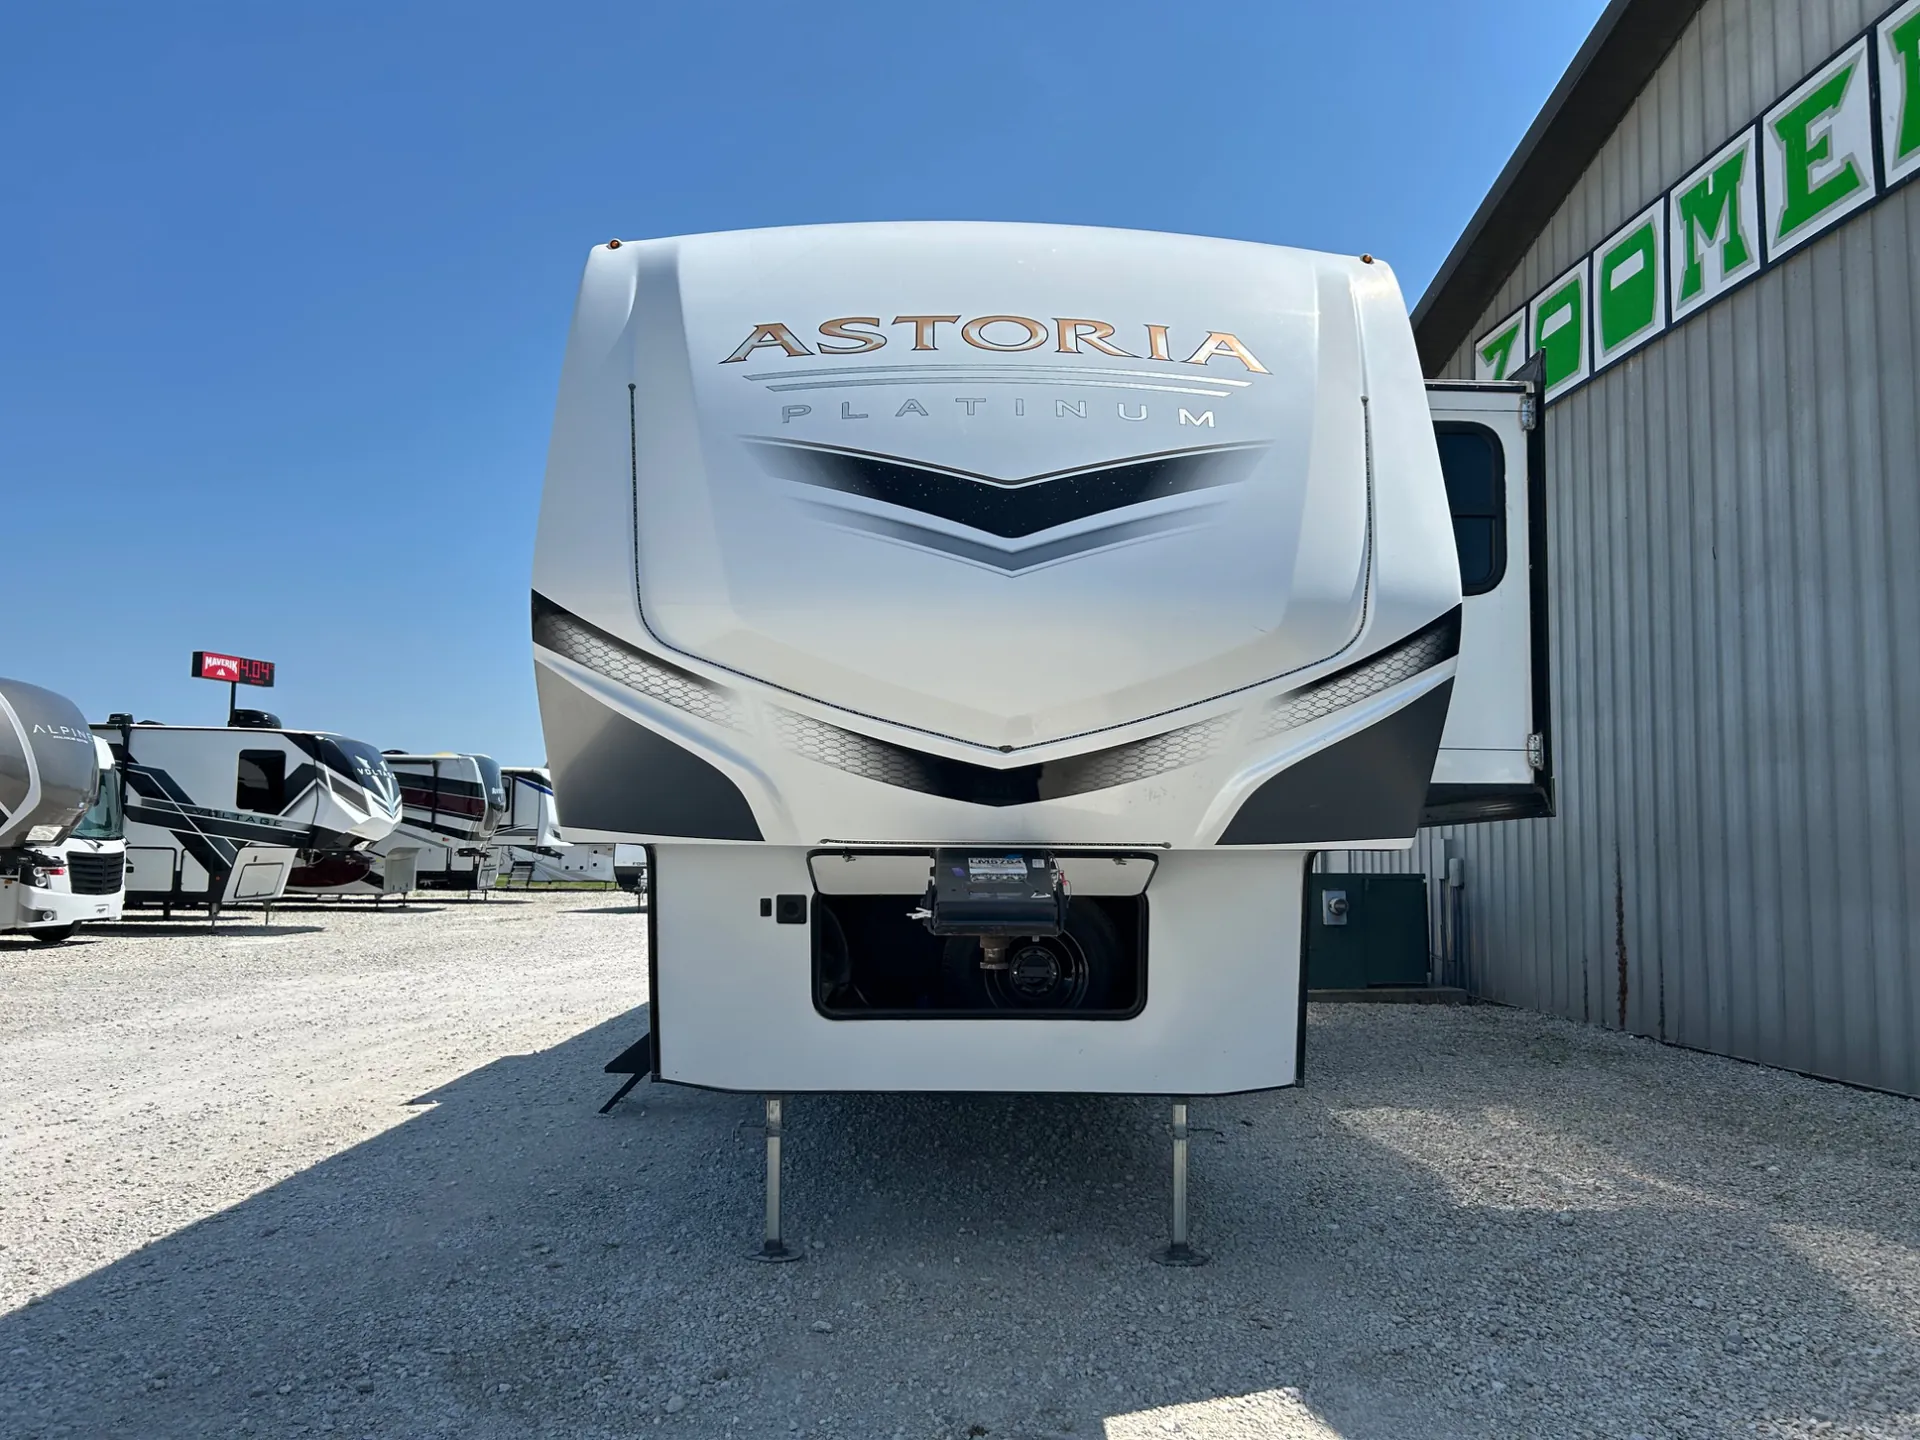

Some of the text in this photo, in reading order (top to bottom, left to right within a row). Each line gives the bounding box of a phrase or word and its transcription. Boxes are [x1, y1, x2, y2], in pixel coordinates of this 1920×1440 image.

[718, 314, 1272, 375] ASTORIA
[781, 397, 1216, 428] PLATINUM
[204, 656, 238, 675] MAVERIK
[33, 724, 94, 743] ALPINE
[194, 807, 283, 828] VOLTAGE
